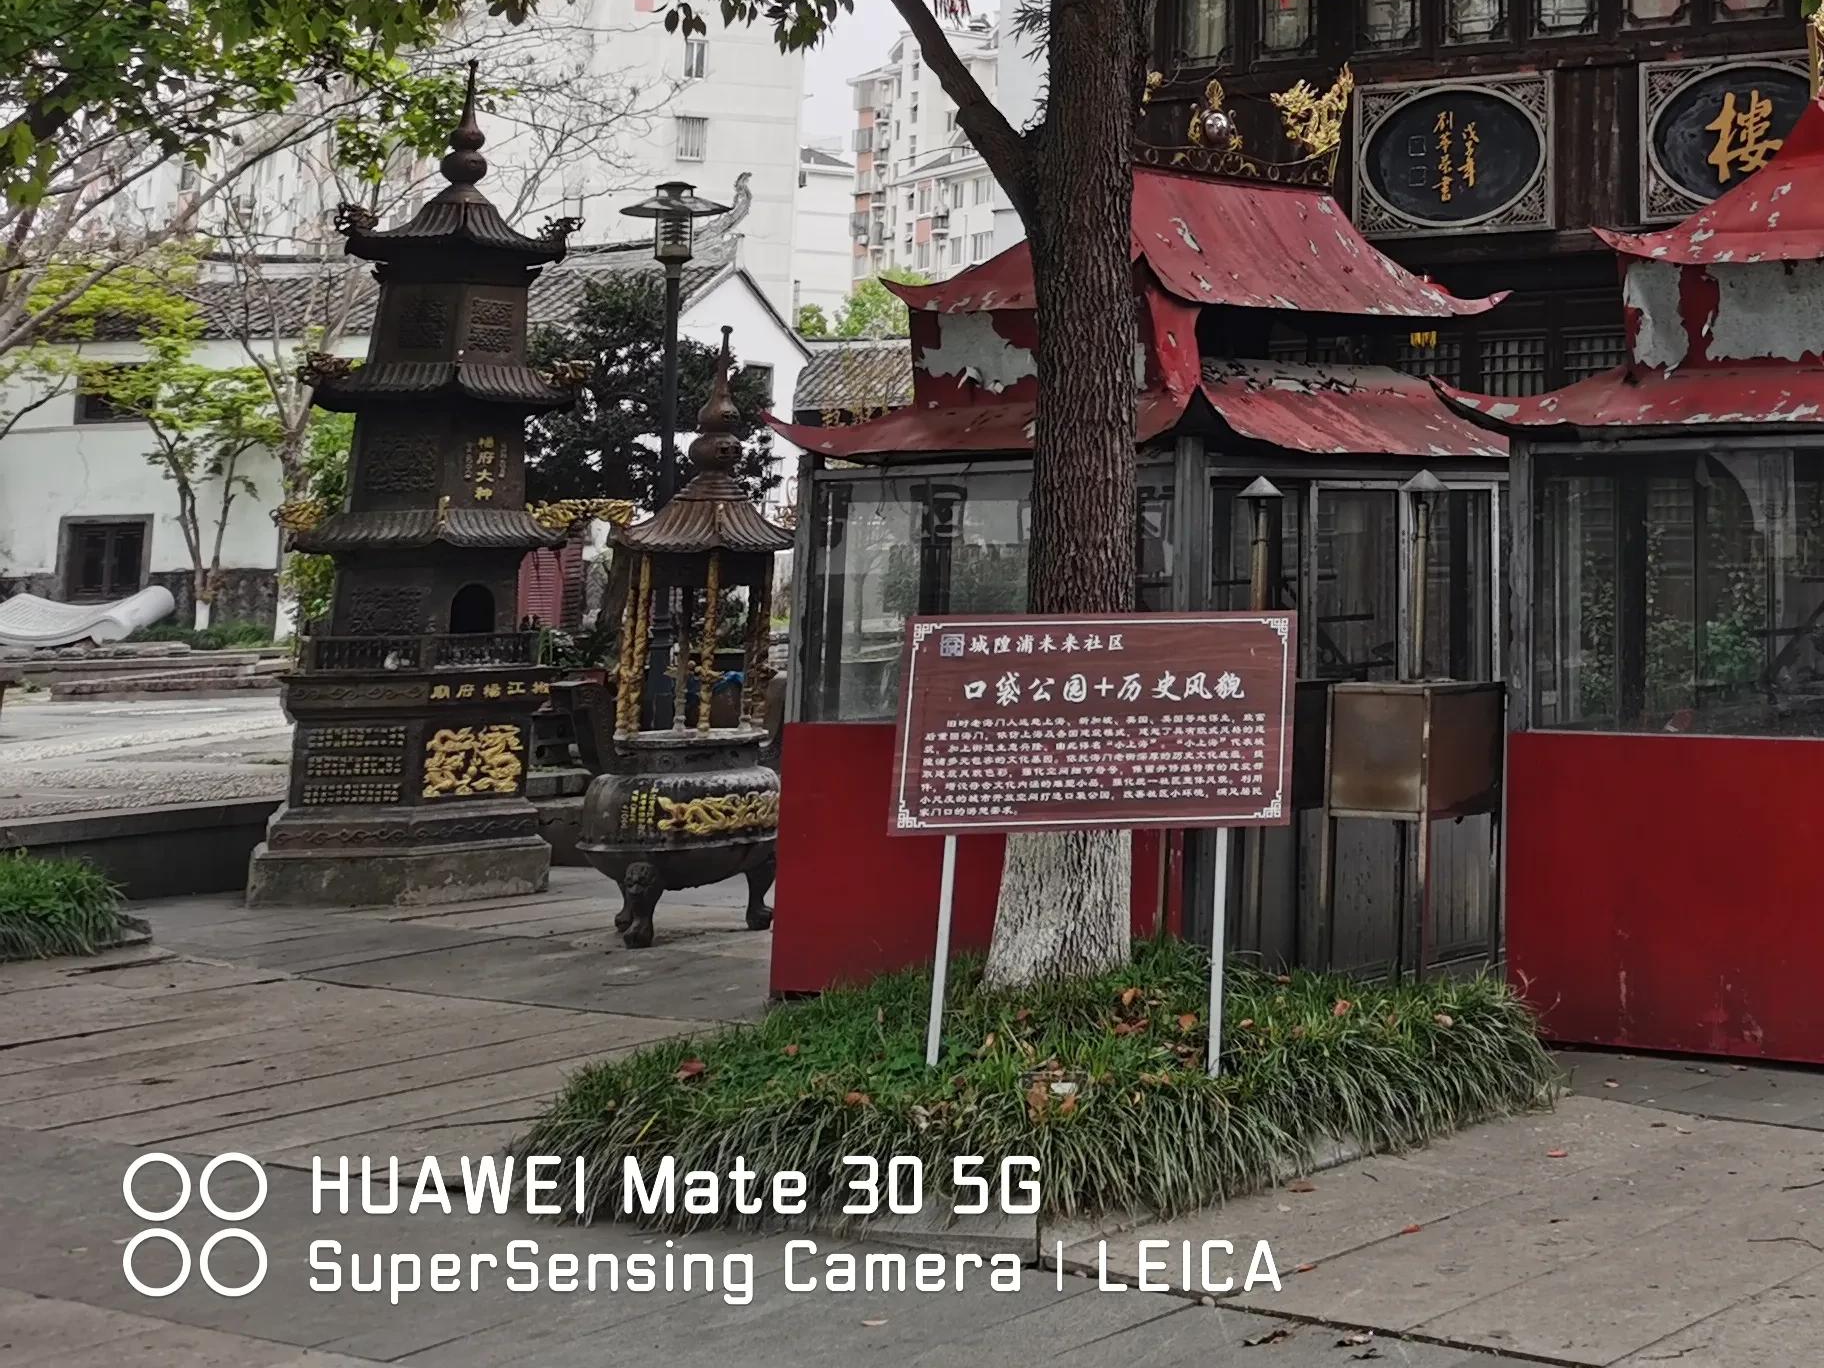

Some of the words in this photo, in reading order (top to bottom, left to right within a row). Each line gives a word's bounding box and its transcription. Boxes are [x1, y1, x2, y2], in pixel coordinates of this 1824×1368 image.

[968, 633, 1126, 656] 城隍浦未来社区
[963, 669, 1246, 708] 口袋公园+历史风貌
